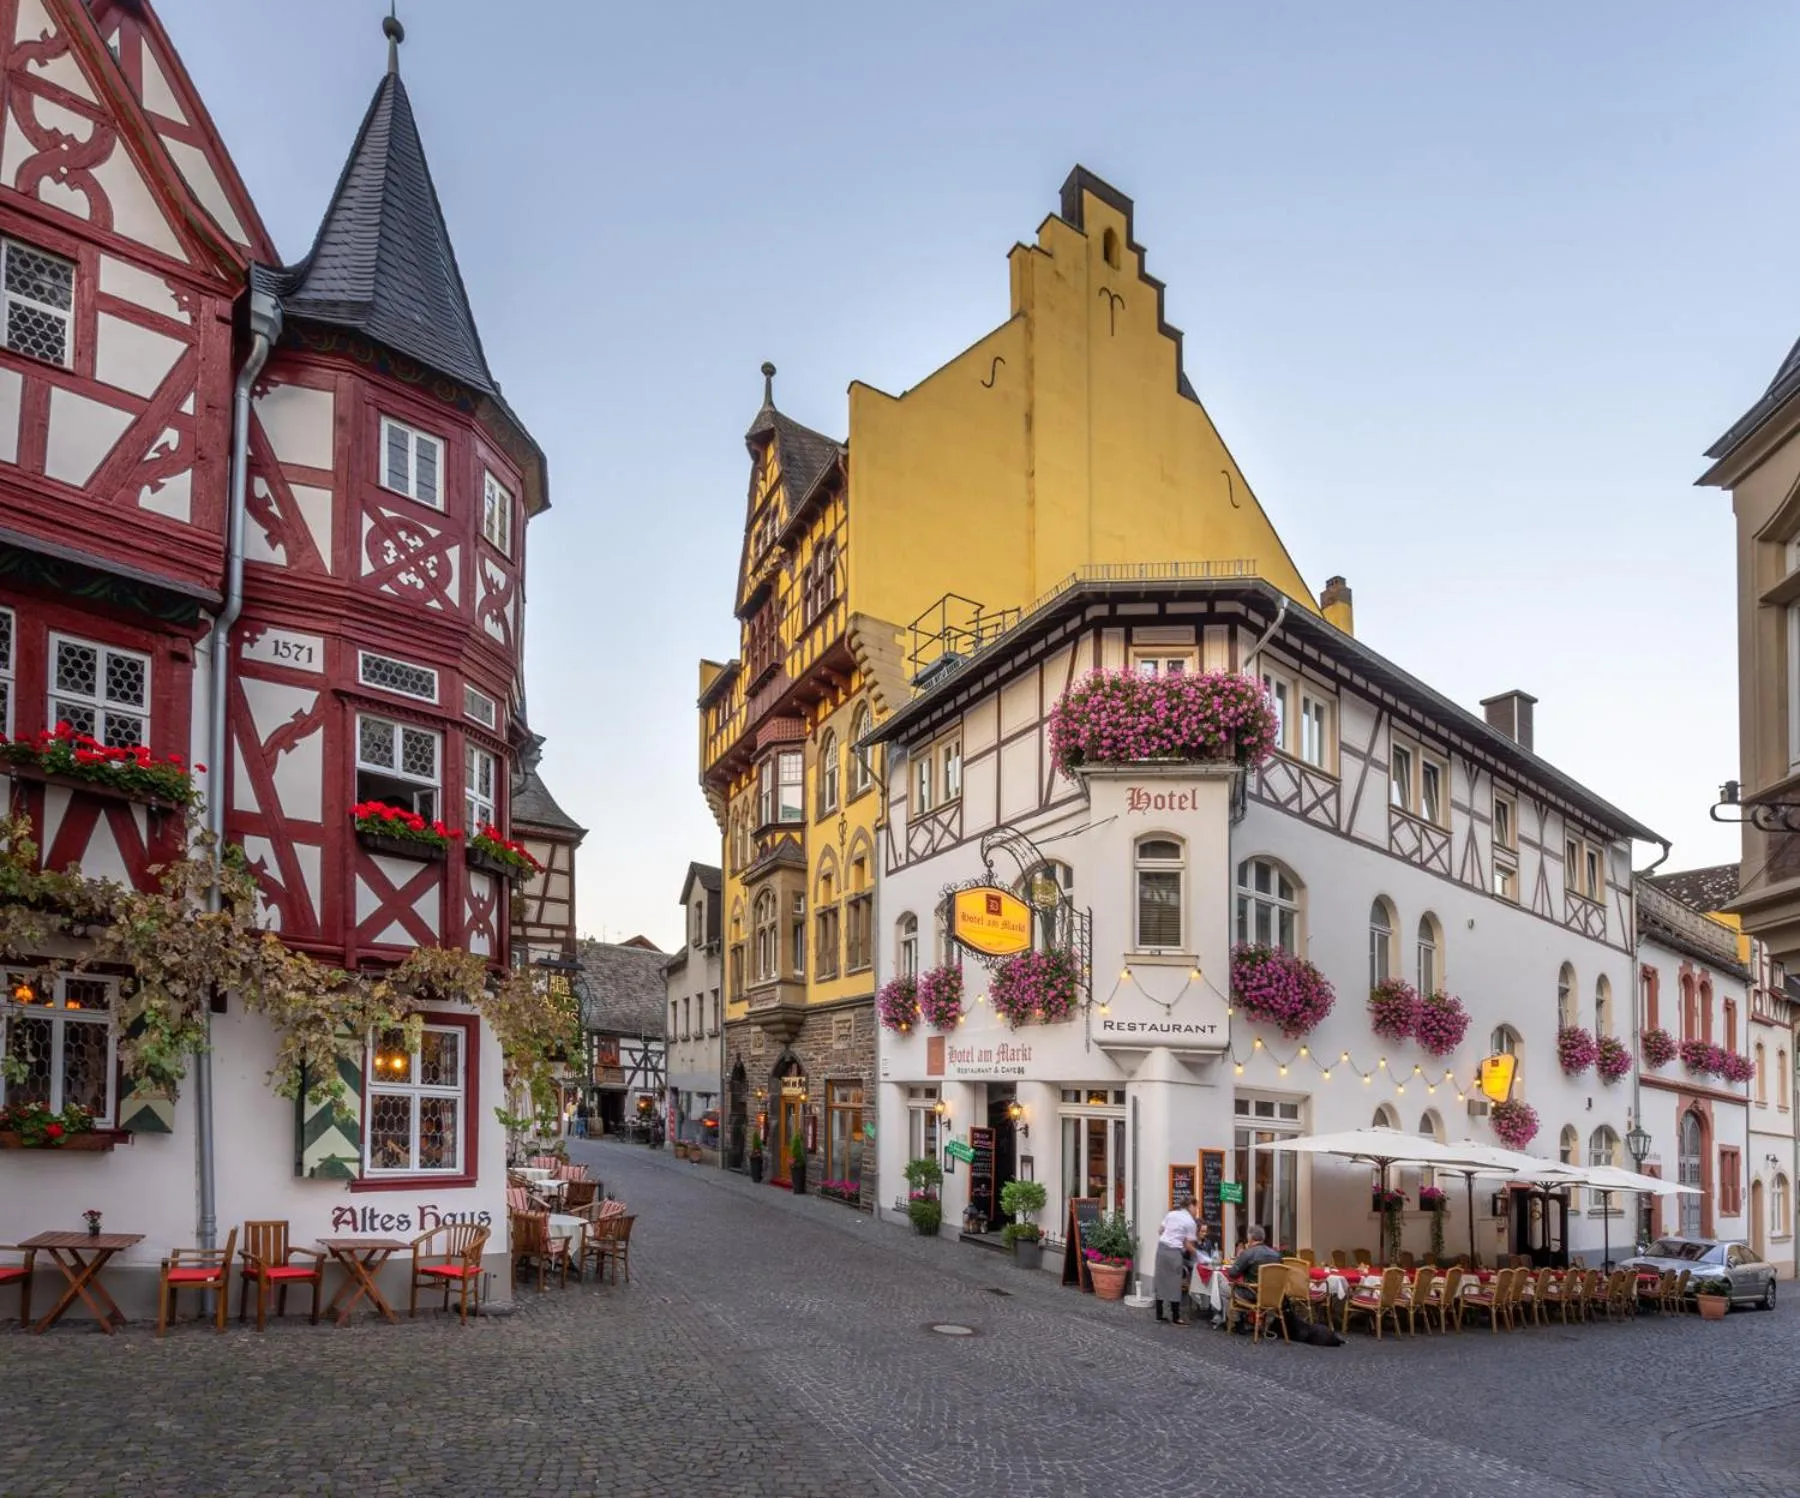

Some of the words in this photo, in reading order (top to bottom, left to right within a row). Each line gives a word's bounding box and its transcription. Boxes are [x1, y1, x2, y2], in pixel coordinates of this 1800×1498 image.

[271, 639, 313, 664] 1571
[1125, 786, 1199, 815] Hotel
[961, 911, 984, 929] Hotel
[987, 919, 999, 928] am
[1001, 920, 1026, 933] Markt
[1103, 1020, 1217, 1034] RESTAURANT
[947, 1045, 974, 1064] Hotel
[977, 1049, 992, 1062] am
[996, 1042, 1032, 1063] Markt
[332, 1205, 412, 1233] Altes
[417, 1204, 492, 1231] Haus
